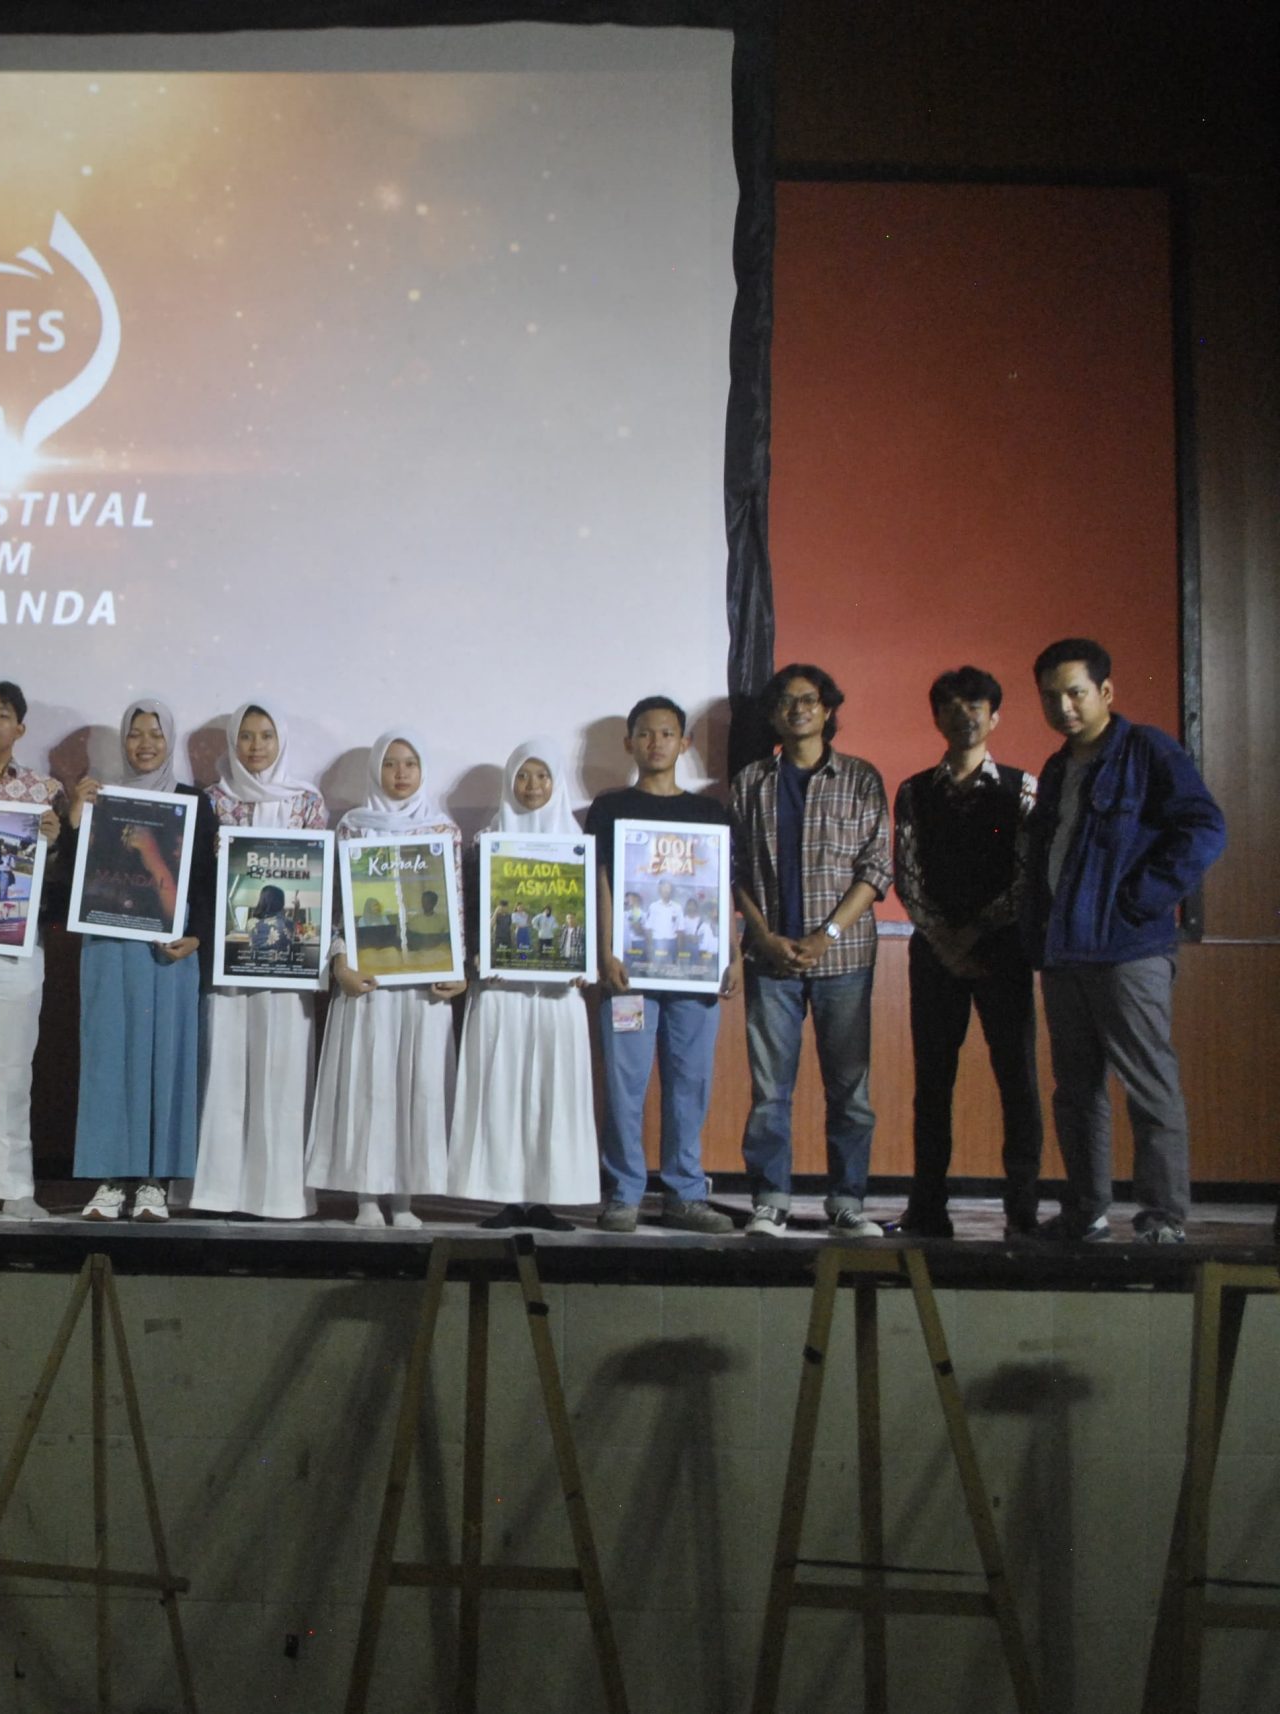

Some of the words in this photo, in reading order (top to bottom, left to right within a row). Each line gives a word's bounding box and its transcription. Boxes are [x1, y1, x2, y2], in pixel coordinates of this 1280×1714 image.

[246, 851, 308, 868] Behind
[368, 854, 429, 876] Kamala
[265, 869, 311, 880] SCREEN
[503, 861, 561, 878] BALADA
[515, 879, 579, 897] ASMARA
